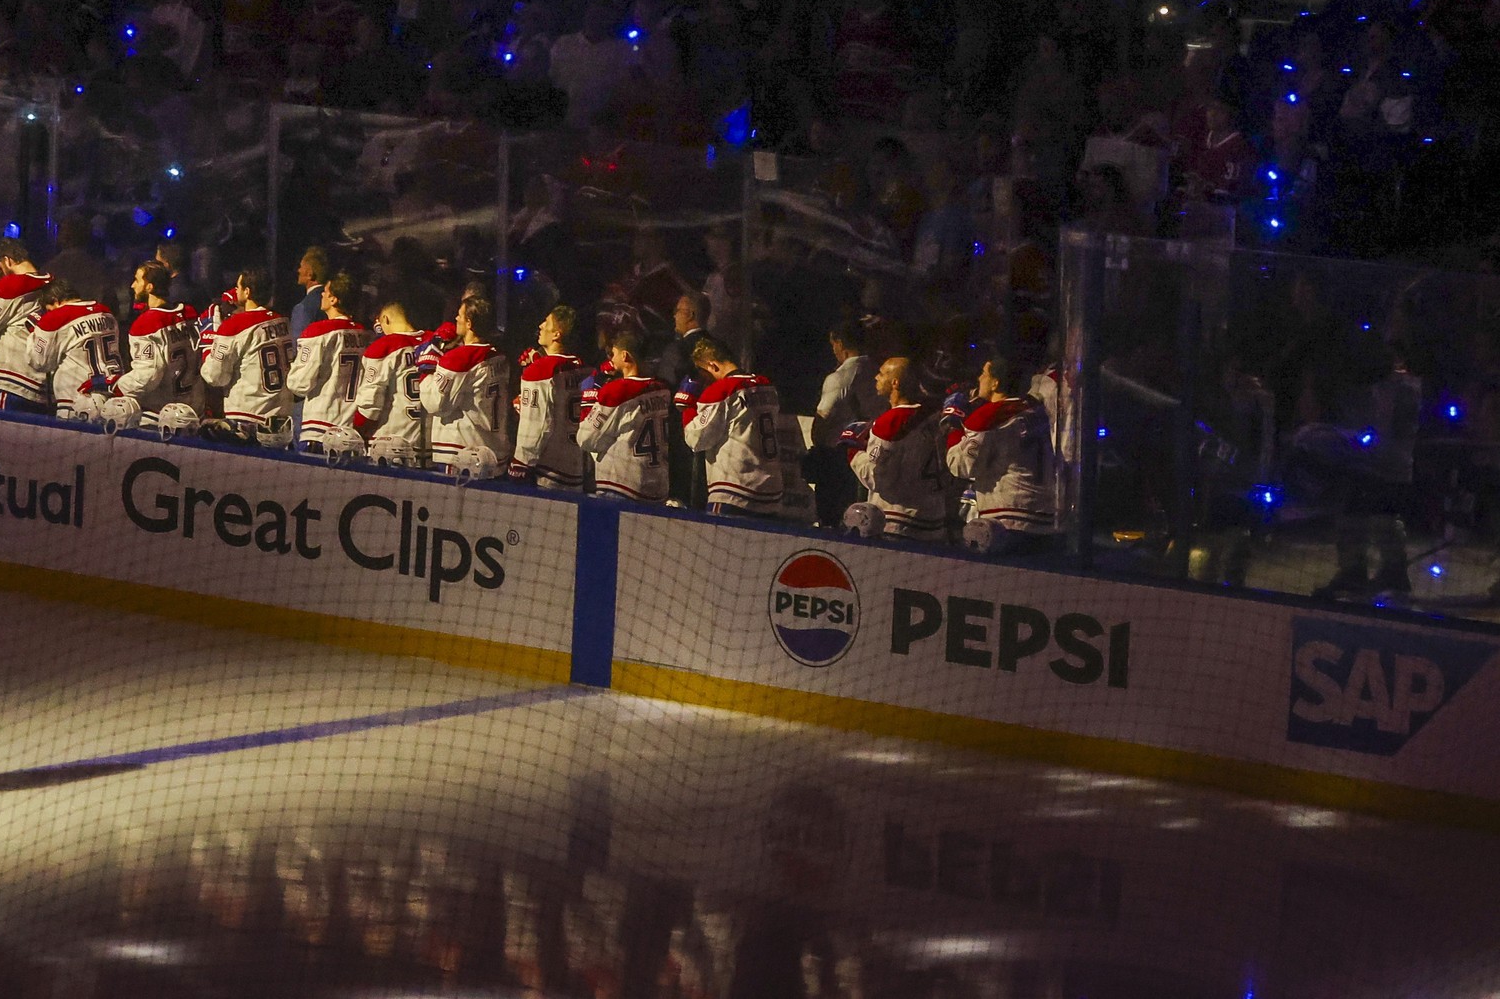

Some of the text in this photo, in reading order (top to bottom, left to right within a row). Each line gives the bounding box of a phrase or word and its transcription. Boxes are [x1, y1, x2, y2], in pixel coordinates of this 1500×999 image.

[83, 333, 125, 377] 15
[132, 343, 154, 360] 24
[121, 456, 321, 560] Great
[775, 592, 854, 625] PEPSI
[890, 587, 1131, 689] PEPSI
[1292, 639, 1446, 735] SAP
